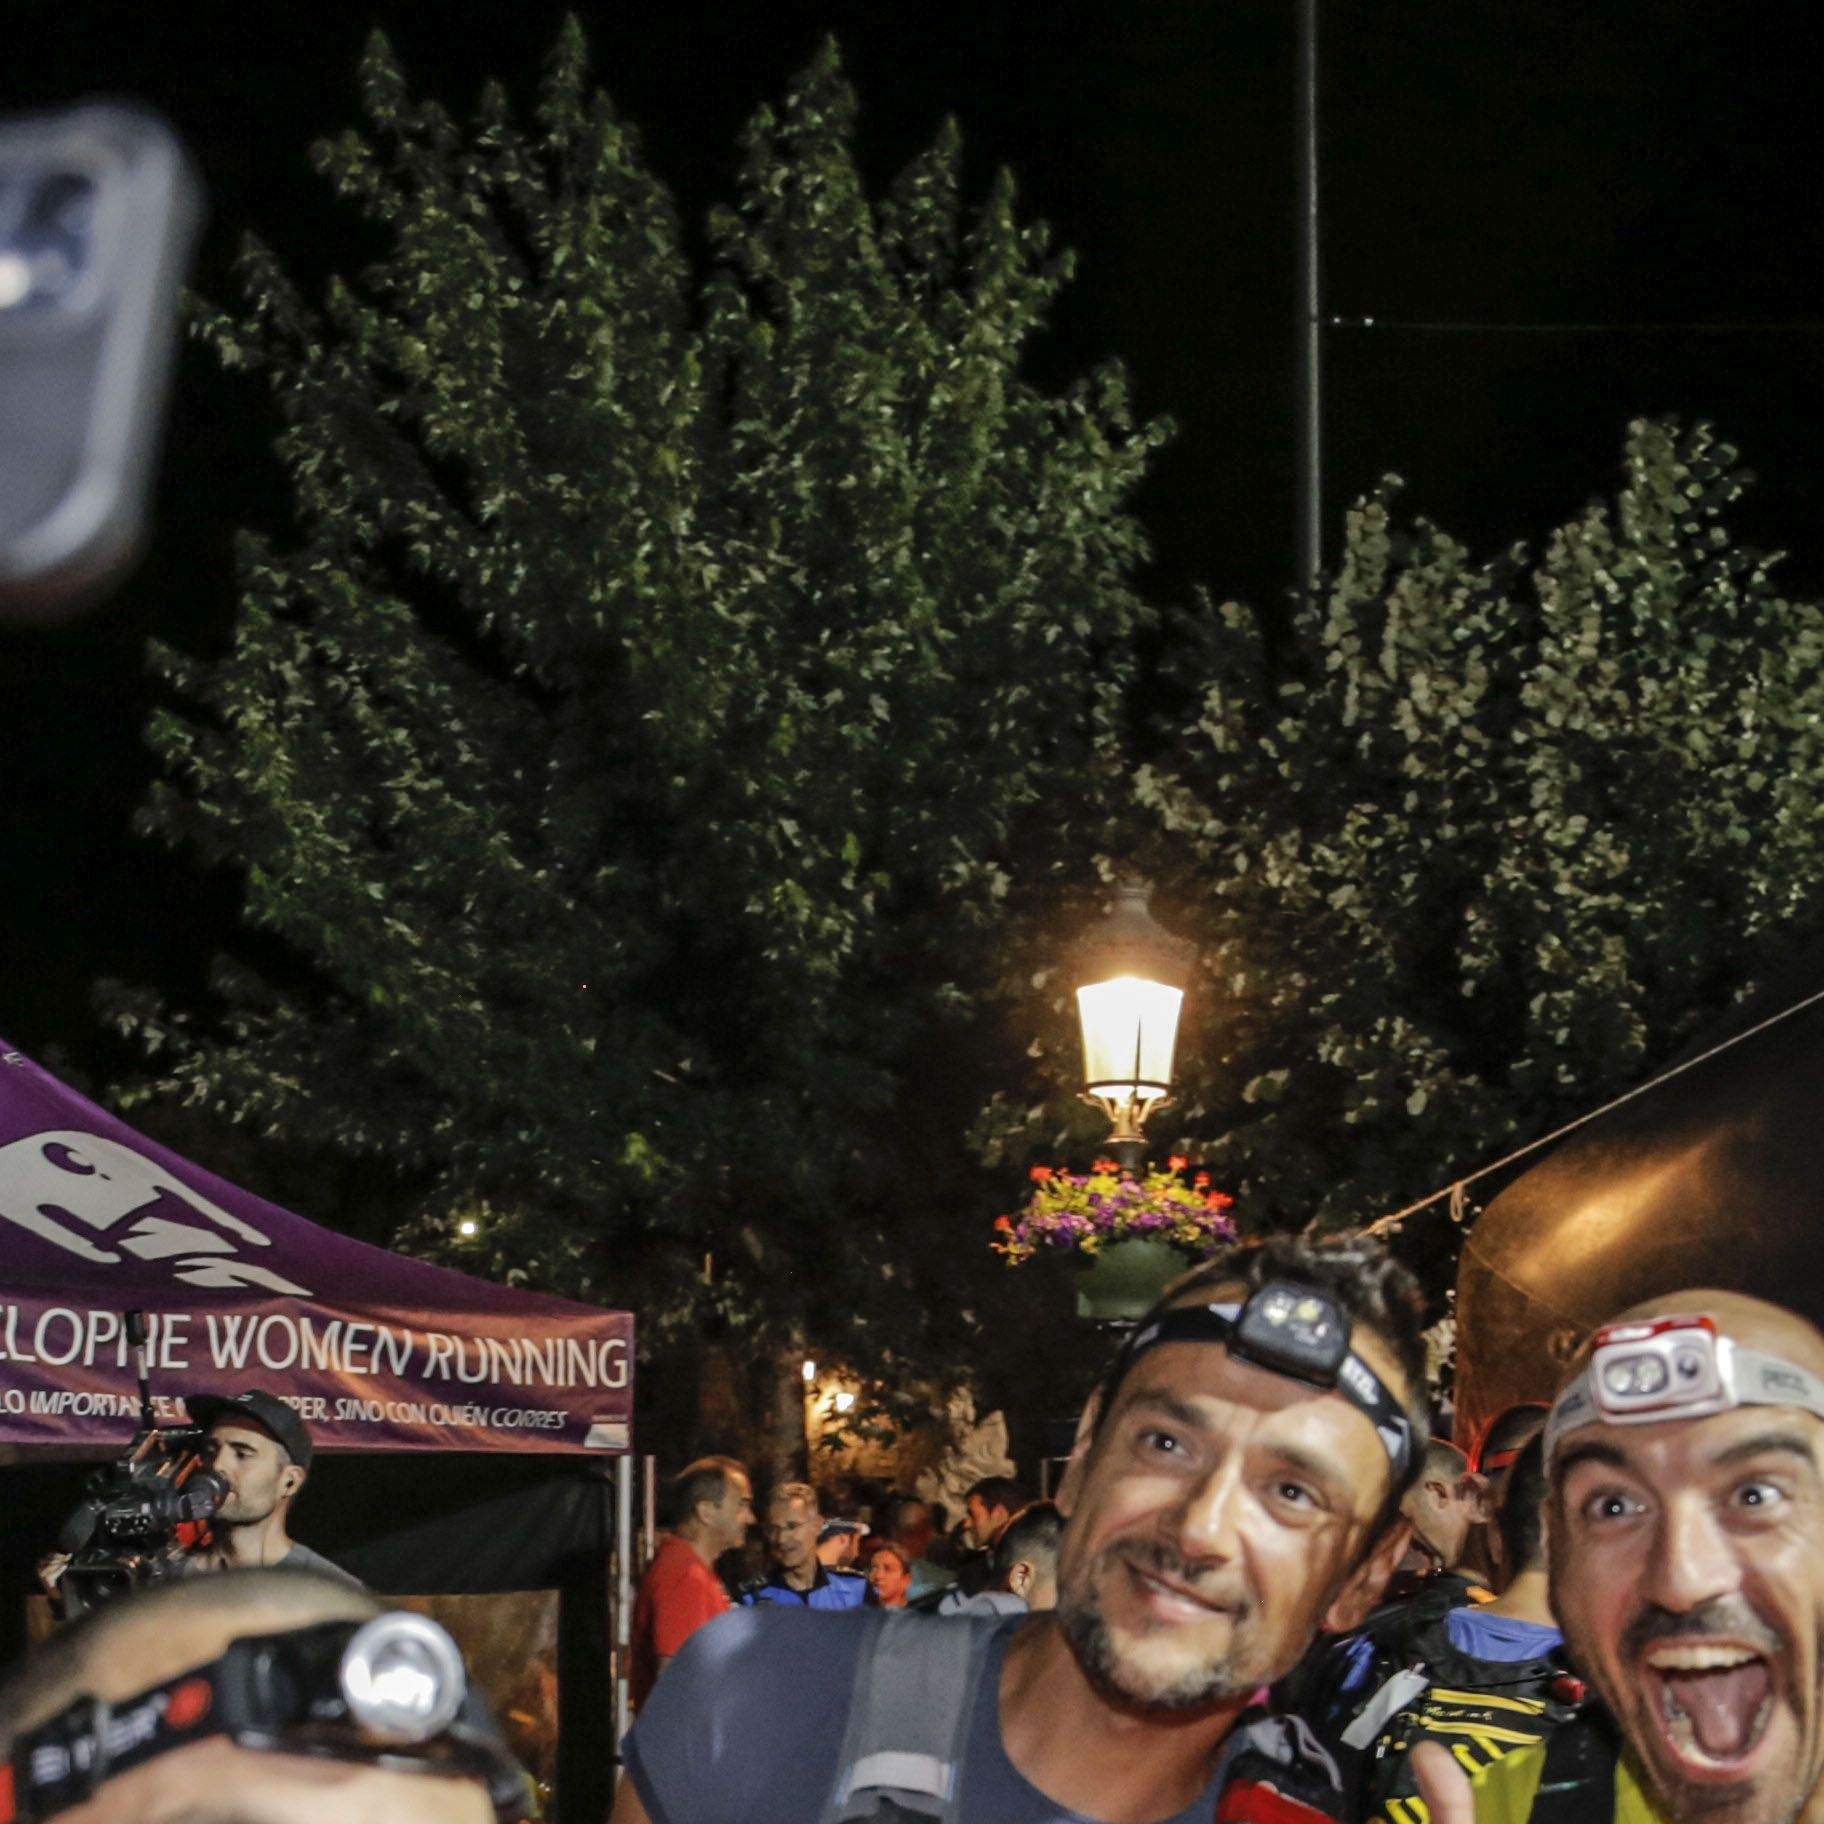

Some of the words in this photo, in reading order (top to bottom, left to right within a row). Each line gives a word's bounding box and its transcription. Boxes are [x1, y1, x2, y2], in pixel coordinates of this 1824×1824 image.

[205, 1315, 413, 1376] WOMEN
[423, 1333, 628, 1388] RUNNING
[334, 1398, 383, 1422] SINO
[385, 1400, 428, 1424] CON
[430, 1398, 488, 1428] QUIÉN
[491, 1406, 569, 1431] CORRES
